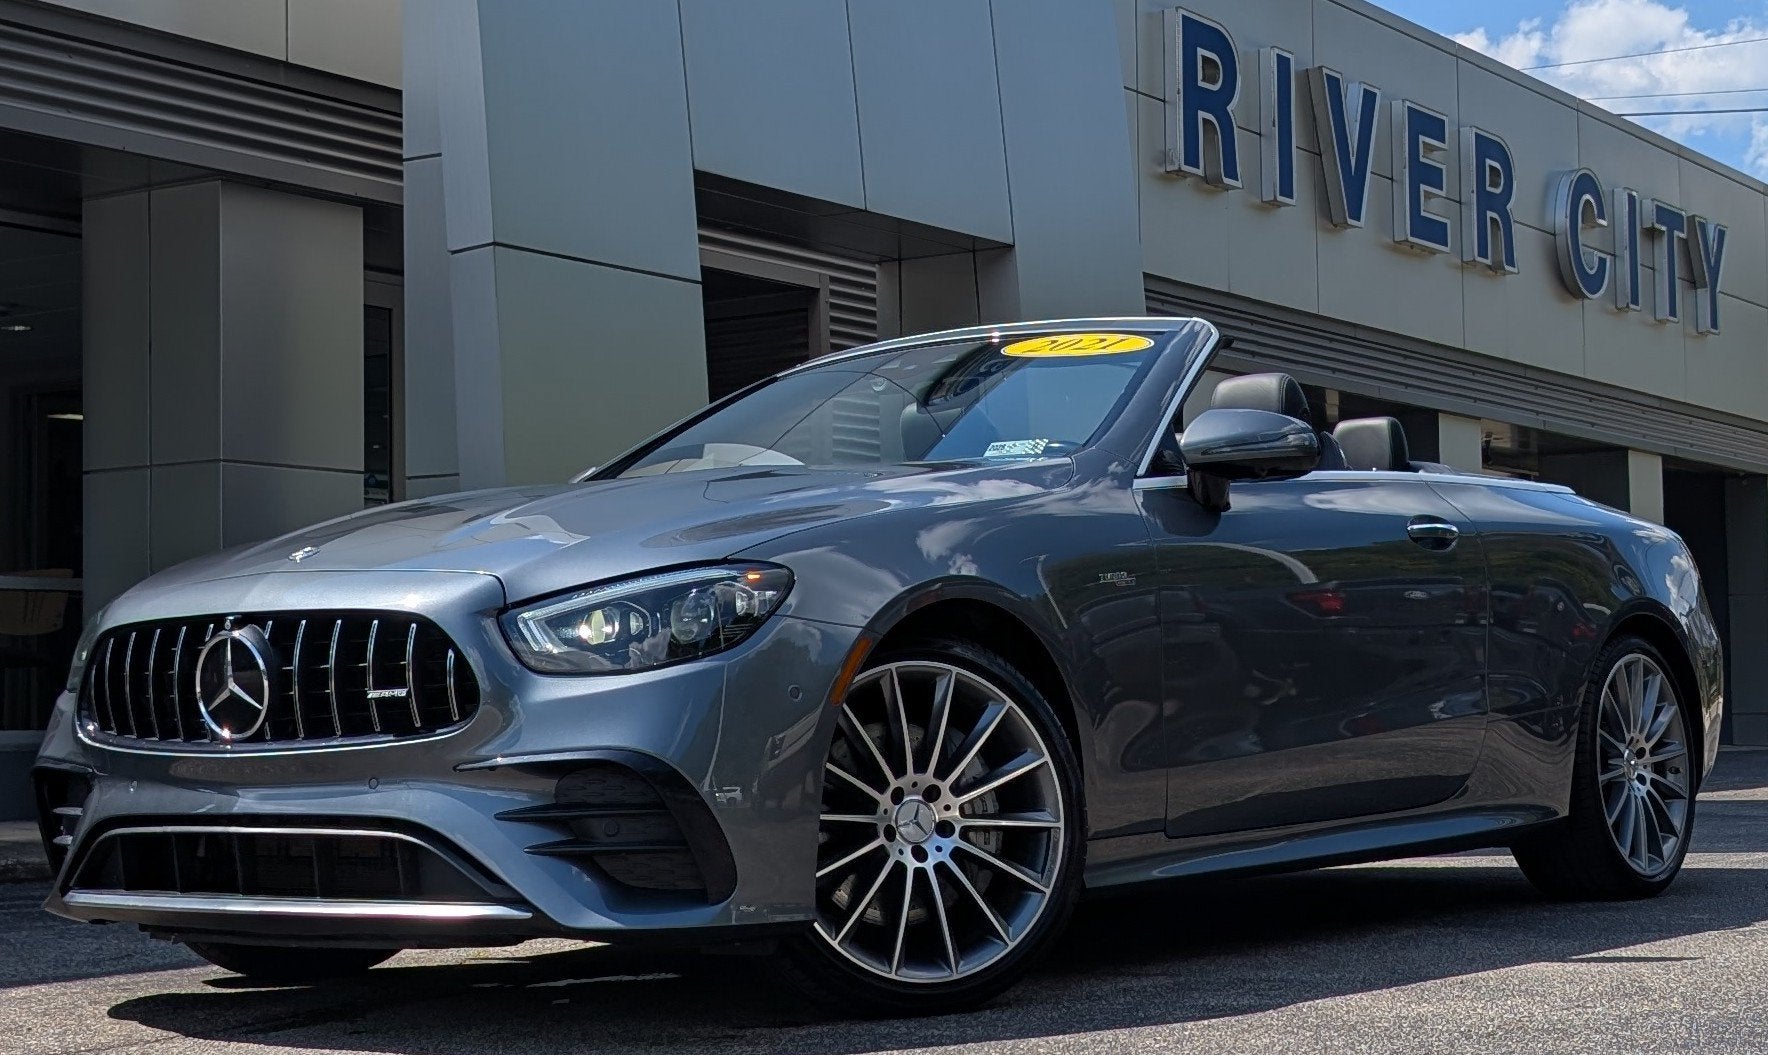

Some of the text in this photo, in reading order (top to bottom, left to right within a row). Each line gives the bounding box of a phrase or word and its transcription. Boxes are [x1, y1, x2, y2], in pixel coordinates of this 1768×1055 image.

[1165, 7, 1728, 335] RIVER CITY
[1022, 337, 1129, 353] 2021
[379, 689, 408, 698] AMG
